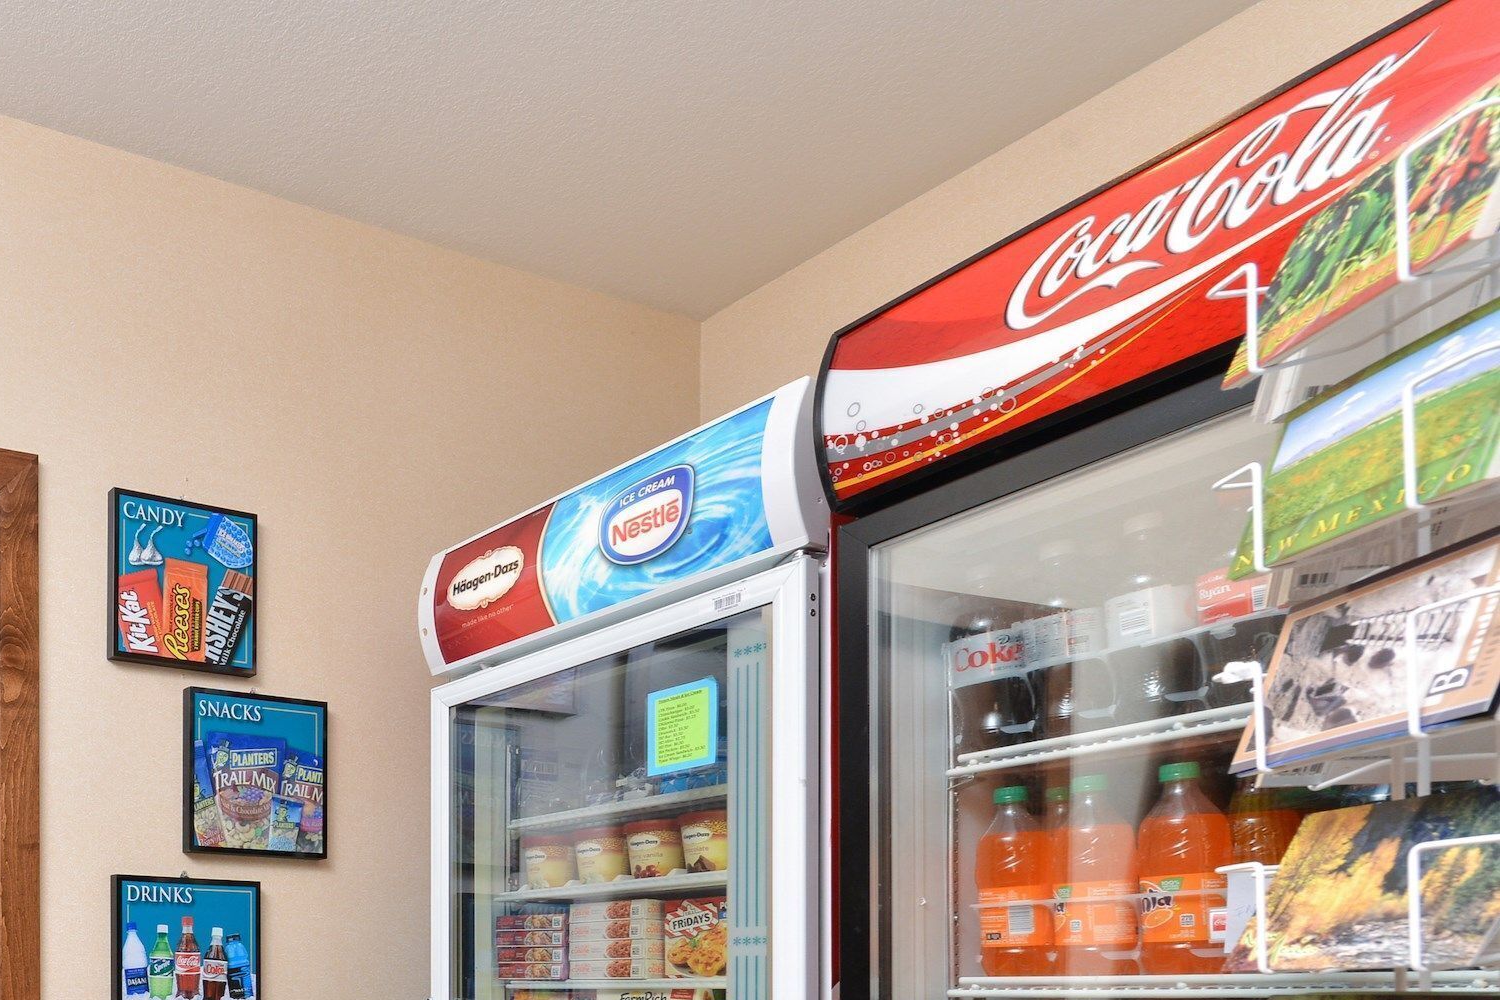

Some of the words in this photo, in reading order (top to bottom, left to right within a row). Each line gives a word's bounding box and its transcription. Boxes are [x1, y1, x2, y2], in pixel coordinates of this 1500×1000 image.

[1004, 27, 1440, 331] Coca-Cola
[618, 490, 636, 508] ICE
[637, 475, 676, 499] CREAM
[123, 501, 186, 528] CANDY
[163, 582, 191, 661] Reese's
[227, 608, 247, 649] Chocolate
[462, 617, 477, 629] made
[477, 613, 488, 624] like
[488, 610, 497, 620] no
[955, 640, 1025, 673] Coke
[198, 699, 262, 723] SNACKS
[231, 752, 275, 767] PLANTERS
[213, 769, 251, 791] TRAIL
[250, 770, 278, 795] MIX
[127, 883, 194, 905] DRINKS
